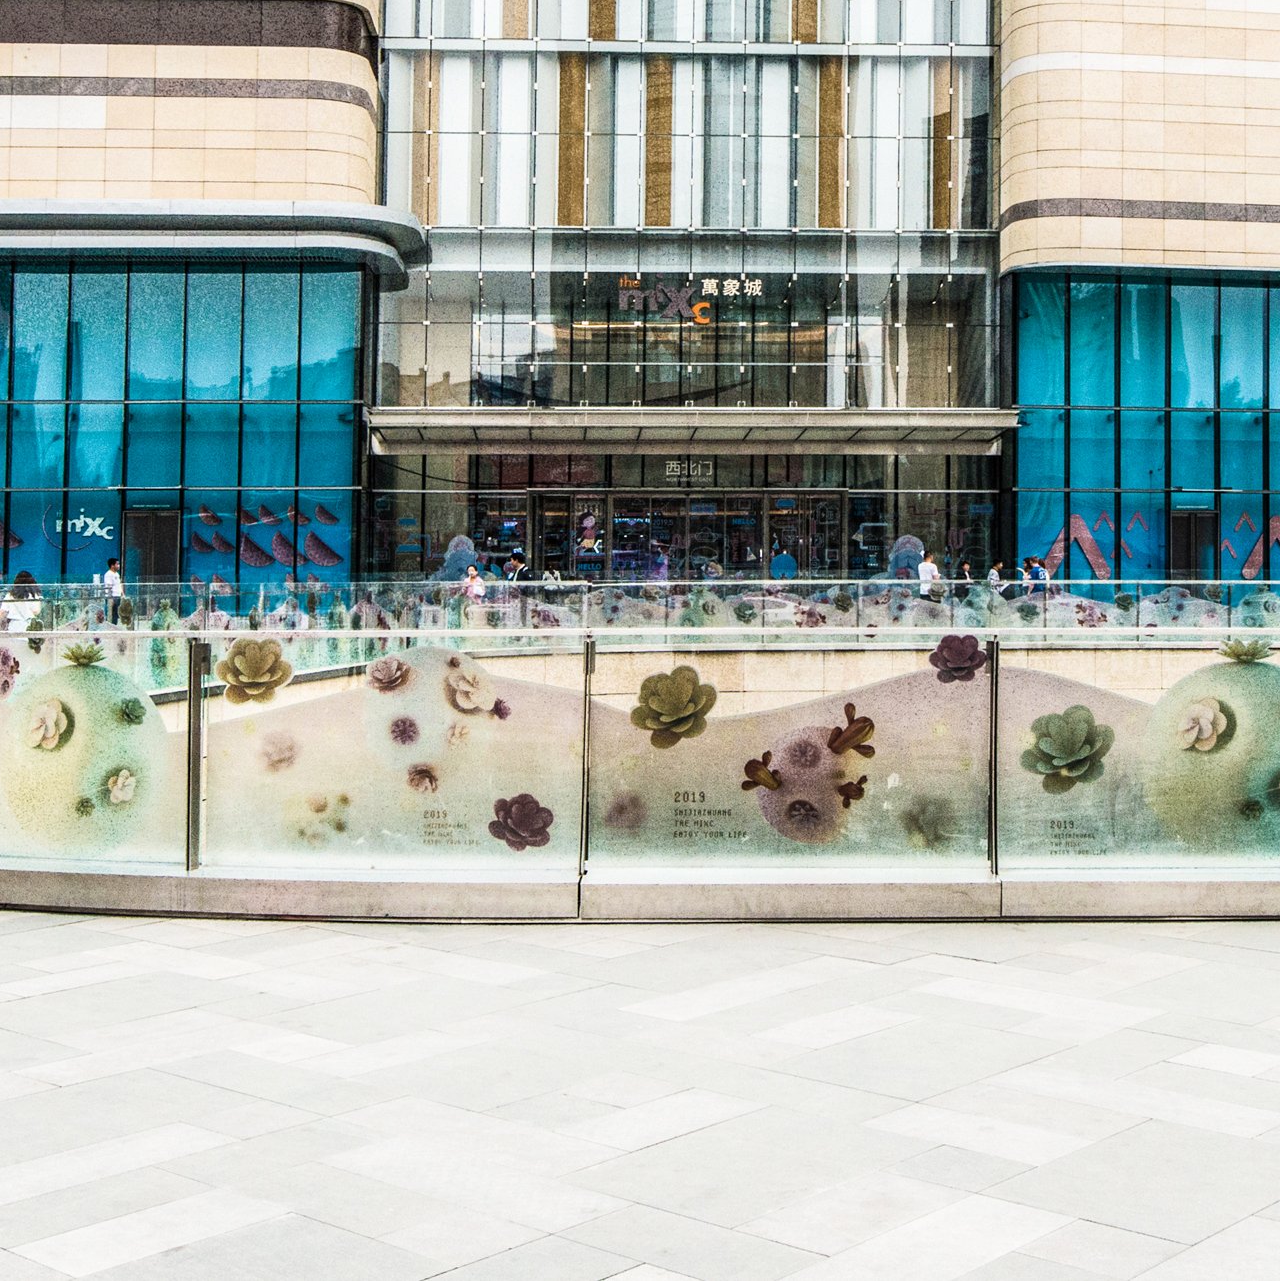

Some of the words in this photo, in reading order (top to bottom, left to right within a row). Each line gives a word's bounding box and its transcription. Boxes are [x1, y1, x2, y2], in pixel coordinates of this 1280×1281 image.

[620, 274, 641, 288] the
[701, 278, 763, 296] 萬象城
[665, 460, 713, 476] 西北门
[674, 791, 706, 803] 2019
[423, 809, 448, 819] 2019
[1050, 820, 1074, 829] 2019
